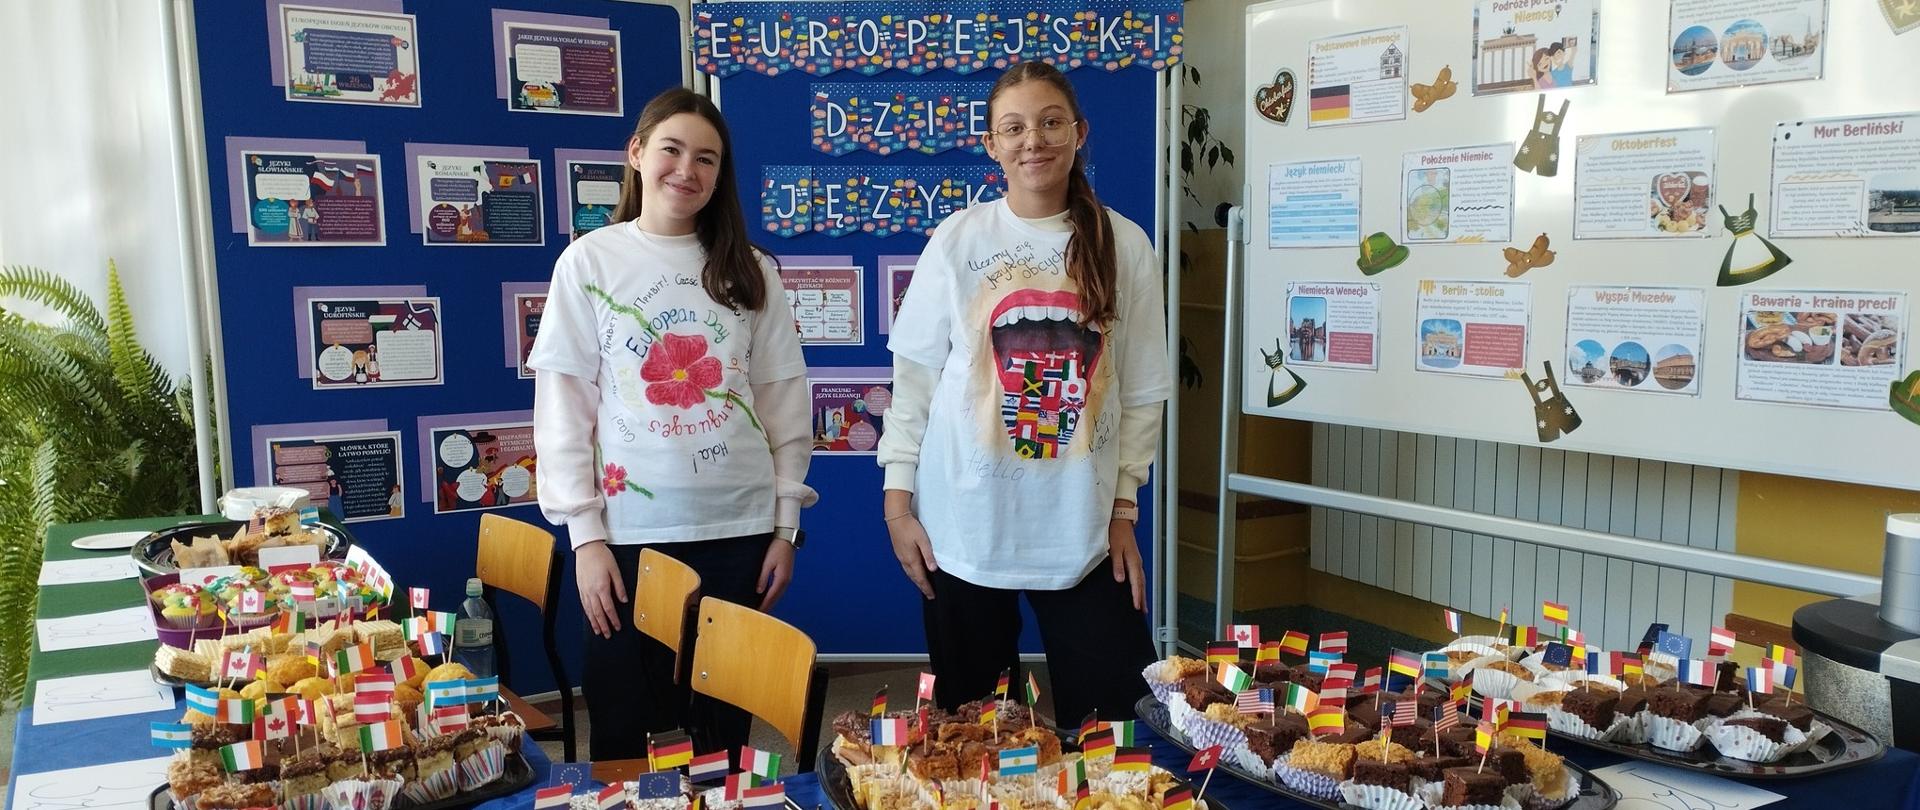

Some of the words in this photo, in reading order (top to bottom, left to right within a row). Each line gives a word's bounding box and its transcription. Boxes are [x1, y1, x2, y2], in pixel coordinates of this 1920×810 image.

[1514, 9, 1554, 24] Niemcy
[711, 14, 1160, 58] EUROPEJSKI
[827, 100, 987, 137] DZIE
[1814, 126, 1840, 139] Mur
[1843, 121, 1904, 137] Berliński
[1611, 136, 1678, 151] Oktoberfest
[1421, 153, 1459, 166] Położenie
[1460, 151, 1494, 163] Niemiec
[1284, 165, 1308, 178] Język
[1308, 162, 1346, 176] niemiecki
[777, 183, 990, 227] JĘZYK
[1298, 285, 1335, 296] Niemiecka
[1335, 285, 1368, 298] Wenecja
[1441, 285, 1467, 296] Berlin
[1475, 286, 1505, 297] stolica
[1594, 290, 1630, 305] Wyspa
[1632, 290, 1677, 304] Muzeów
[1752, 294, 1802, 308] Bawaria
[1812, 295, 1855, 309] kraina
[1857, 297, 1898, 312] precli
[626, 307, 698, 360] European
[703, 309, 730, 345] Day
[648, 388, 743, 439] Languages
